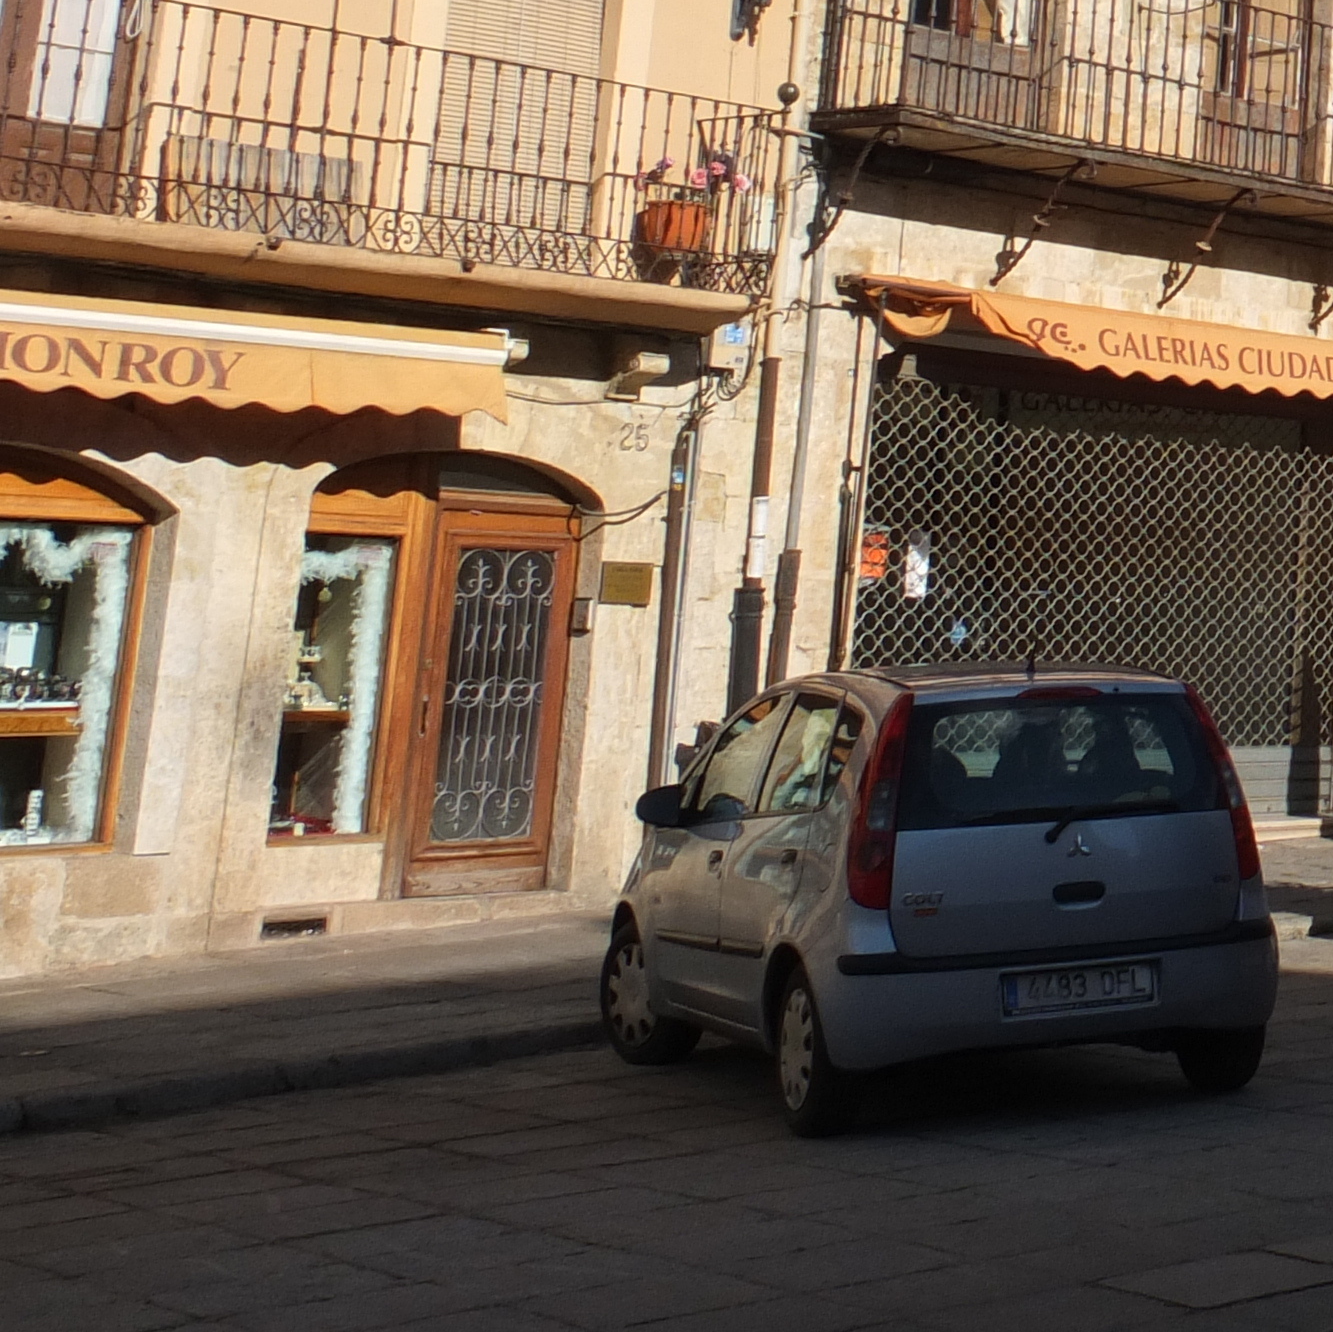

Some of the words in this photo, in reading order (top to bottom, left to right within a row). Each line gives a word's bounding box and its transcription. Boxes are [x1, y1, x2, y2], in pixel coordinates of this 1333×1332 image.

[1098, 327, 1231, 372] GALERIAS
[619, 421, 650, 452] 25
[902, 891, 945, 907] COLT
[1101, 967, 1146, 996] DFL
